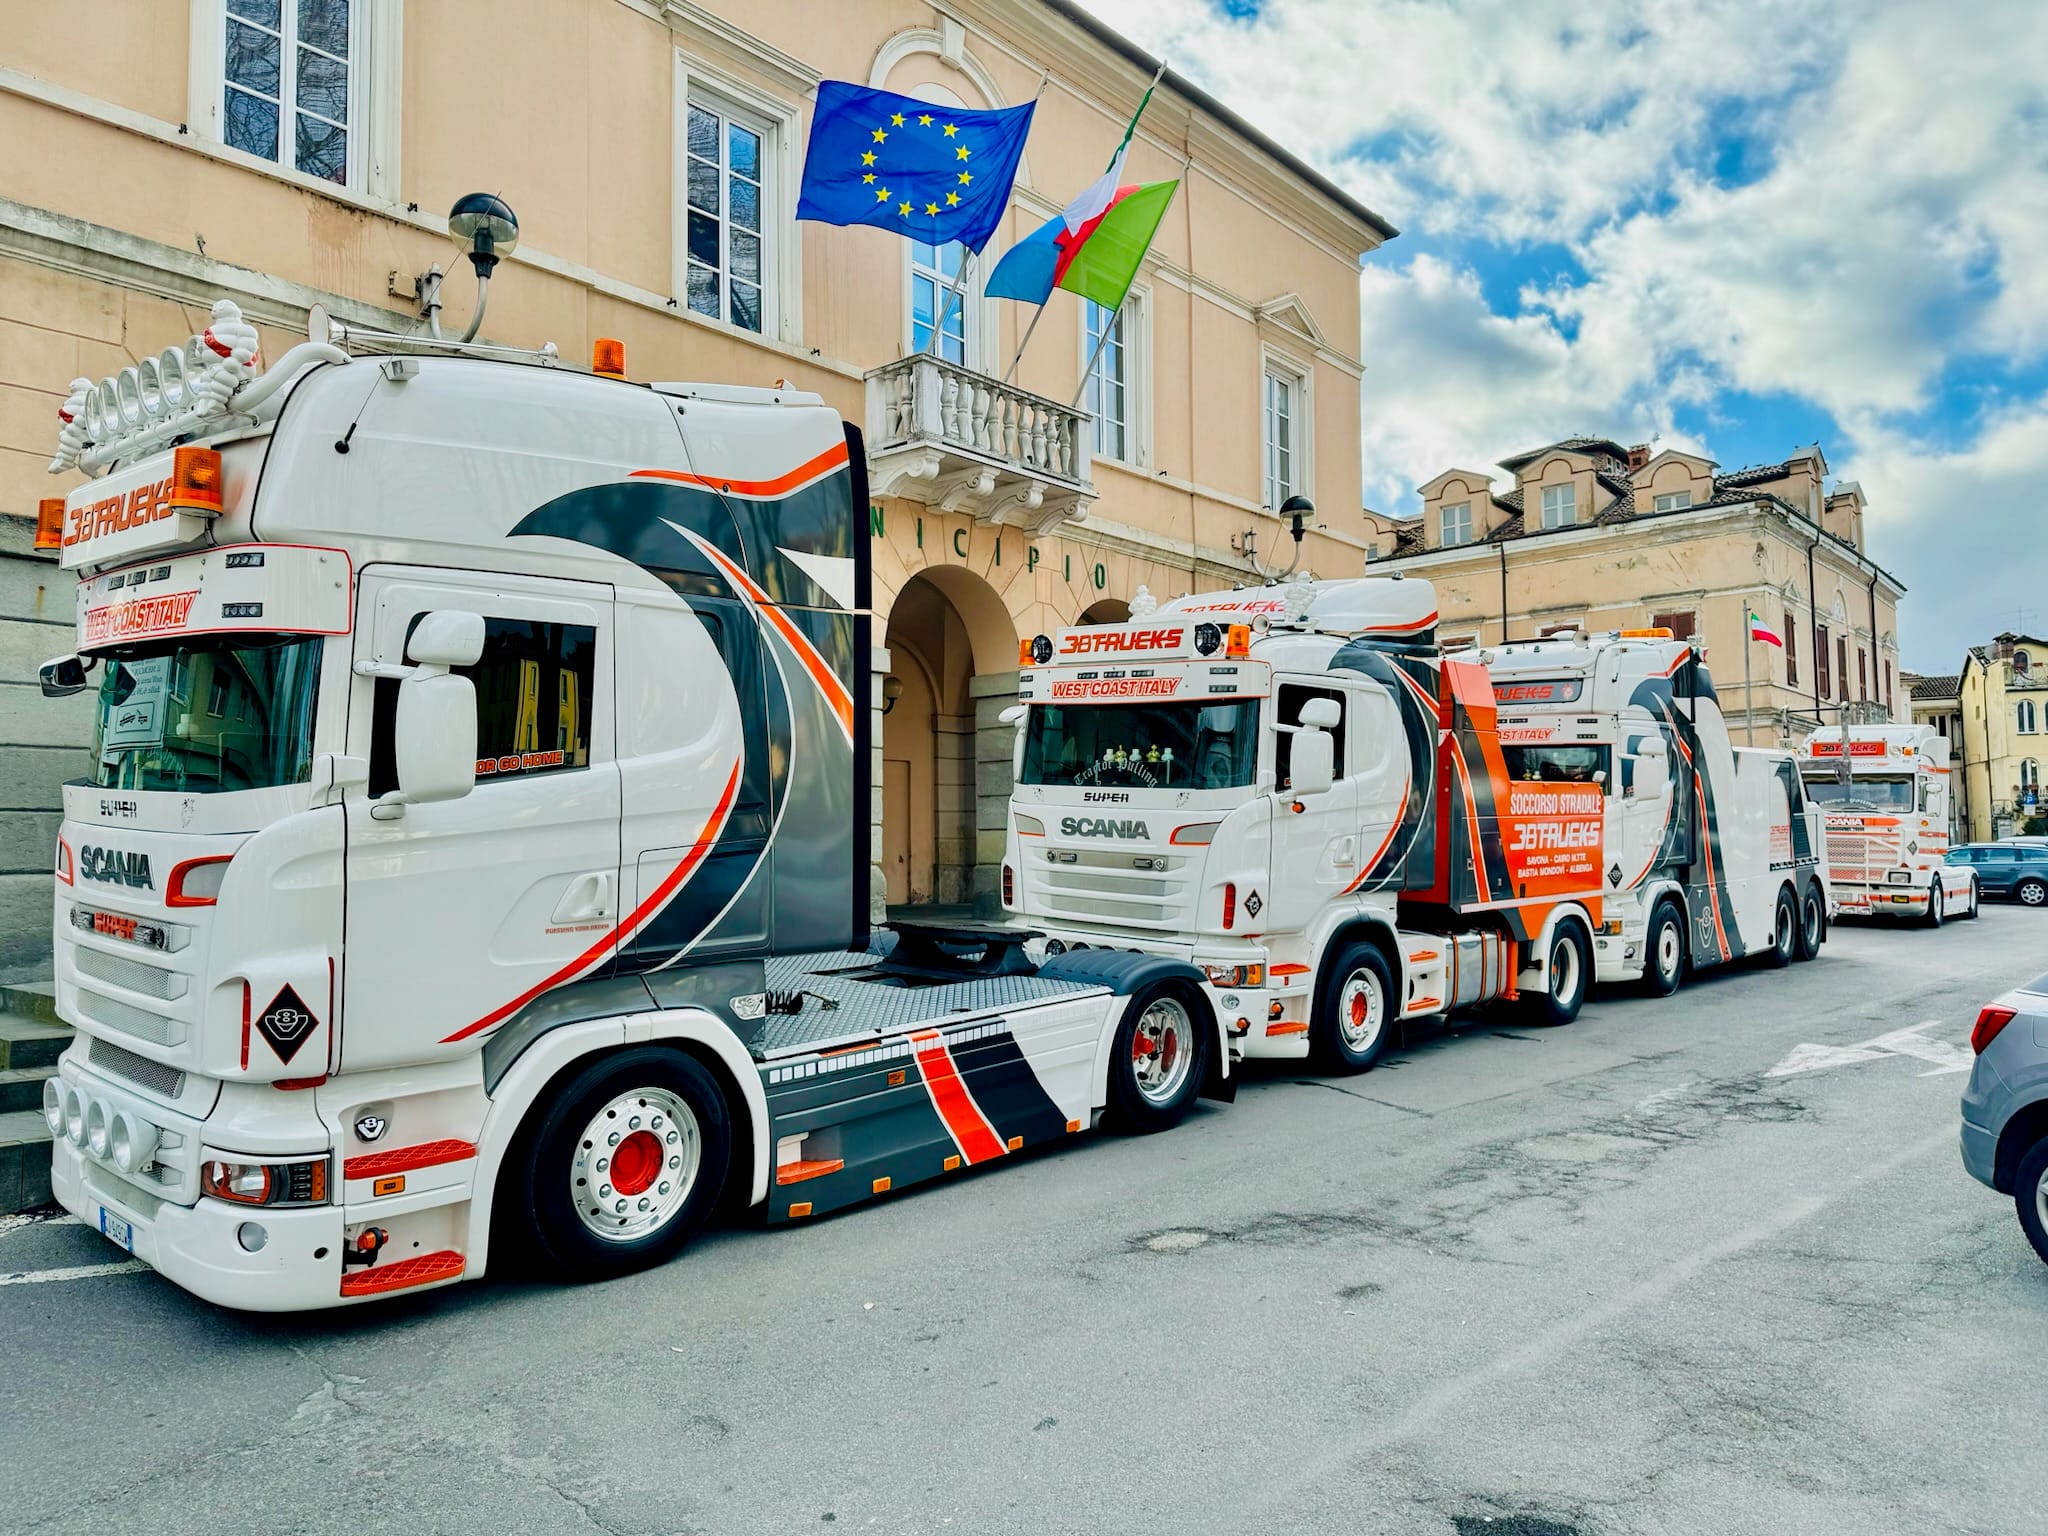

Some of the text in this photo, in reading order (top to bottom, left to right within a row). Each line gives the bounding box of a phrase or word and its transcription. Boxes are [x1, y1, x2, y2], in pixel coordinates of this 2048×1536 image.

[87, 591, 197, 640] WEST COAST ITALY
[1053, 677, 1181, 698] WEST COAST ITALY
[1518, 729, 1553, 740] ITALY
[475, 750, 564, 774] OR GO HOME
[1083, 792, 1130, 803] SUPER
[1511, 793, 1602, 815] SOCCORSO STRADALE
[101, 799, 137, 818] SUPER
[1060, 816, 1151, 841] SCANIA
[80, 845, 156, 891] SCANIA
[1526, 855, 1549, 865] SAVONA
[1518, 867, 1538, 878] BASTIA
